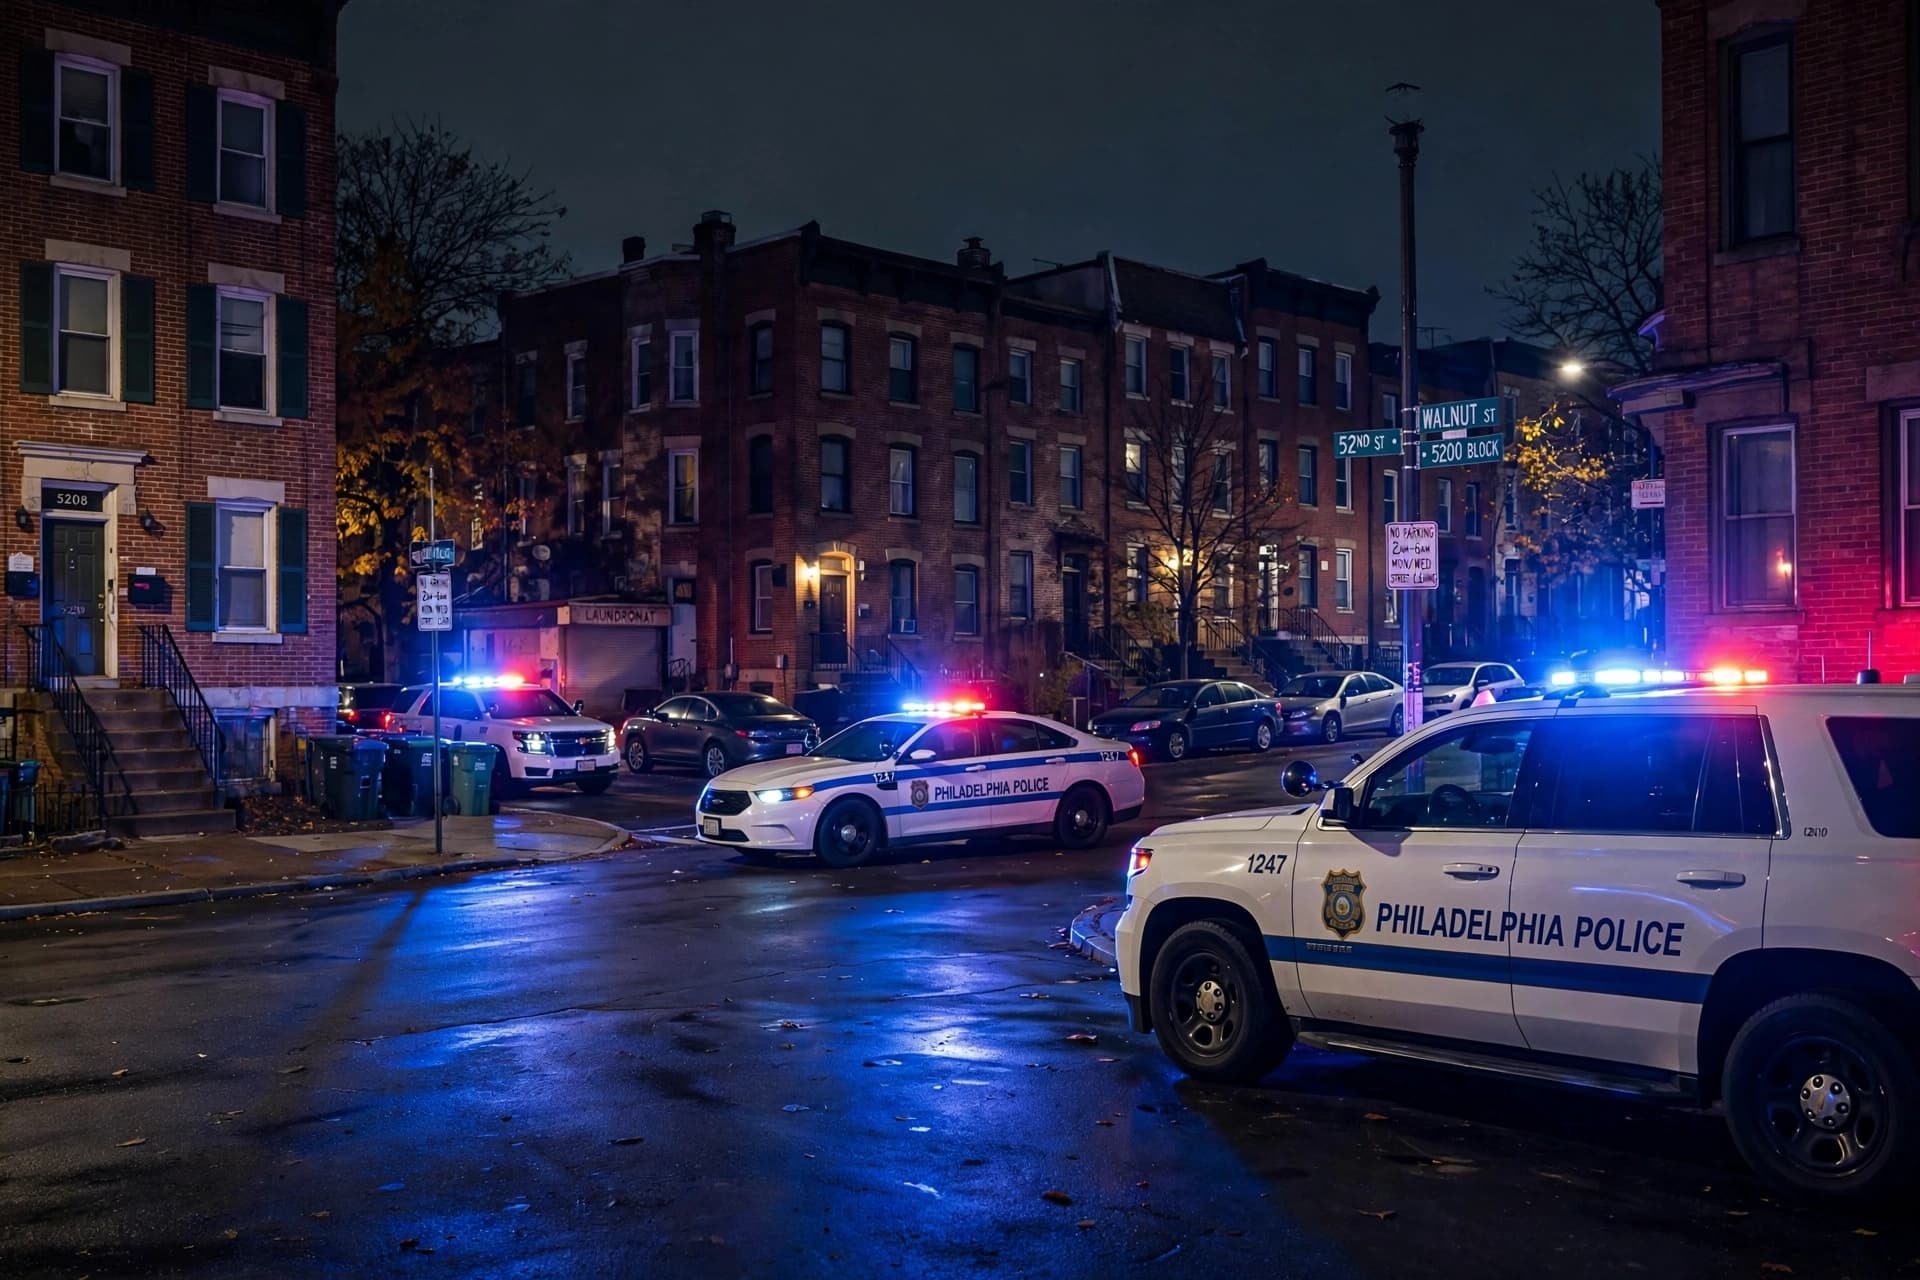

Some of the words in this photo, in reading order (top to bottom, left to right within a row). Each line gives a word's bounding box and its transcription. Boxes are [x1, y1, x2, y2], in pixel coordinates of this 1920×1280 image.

[1422, 403, 1478, 430] WALNUT
[1483, 408, 1497, 423] ST
[1338, 434, 1370, 455] 52ND
[1374, 435, 1385, 450] ST
[1431, 442, 1463, 464] 5200
[1467, 440, 1499, 459] BLOCK
[57, 493, 88, 506] 5208
[1390, 527, 1400, 538] NO
[935, 781, 1011, 800] PHILADELPHIA
[1013, 777, 1049, 793] POLICE
[1248, 853, 1288, 874] 1247
[1375, 902, 1564, 947] PHILADELPHIA
[1573, 915, 1685, 957] POLICE
